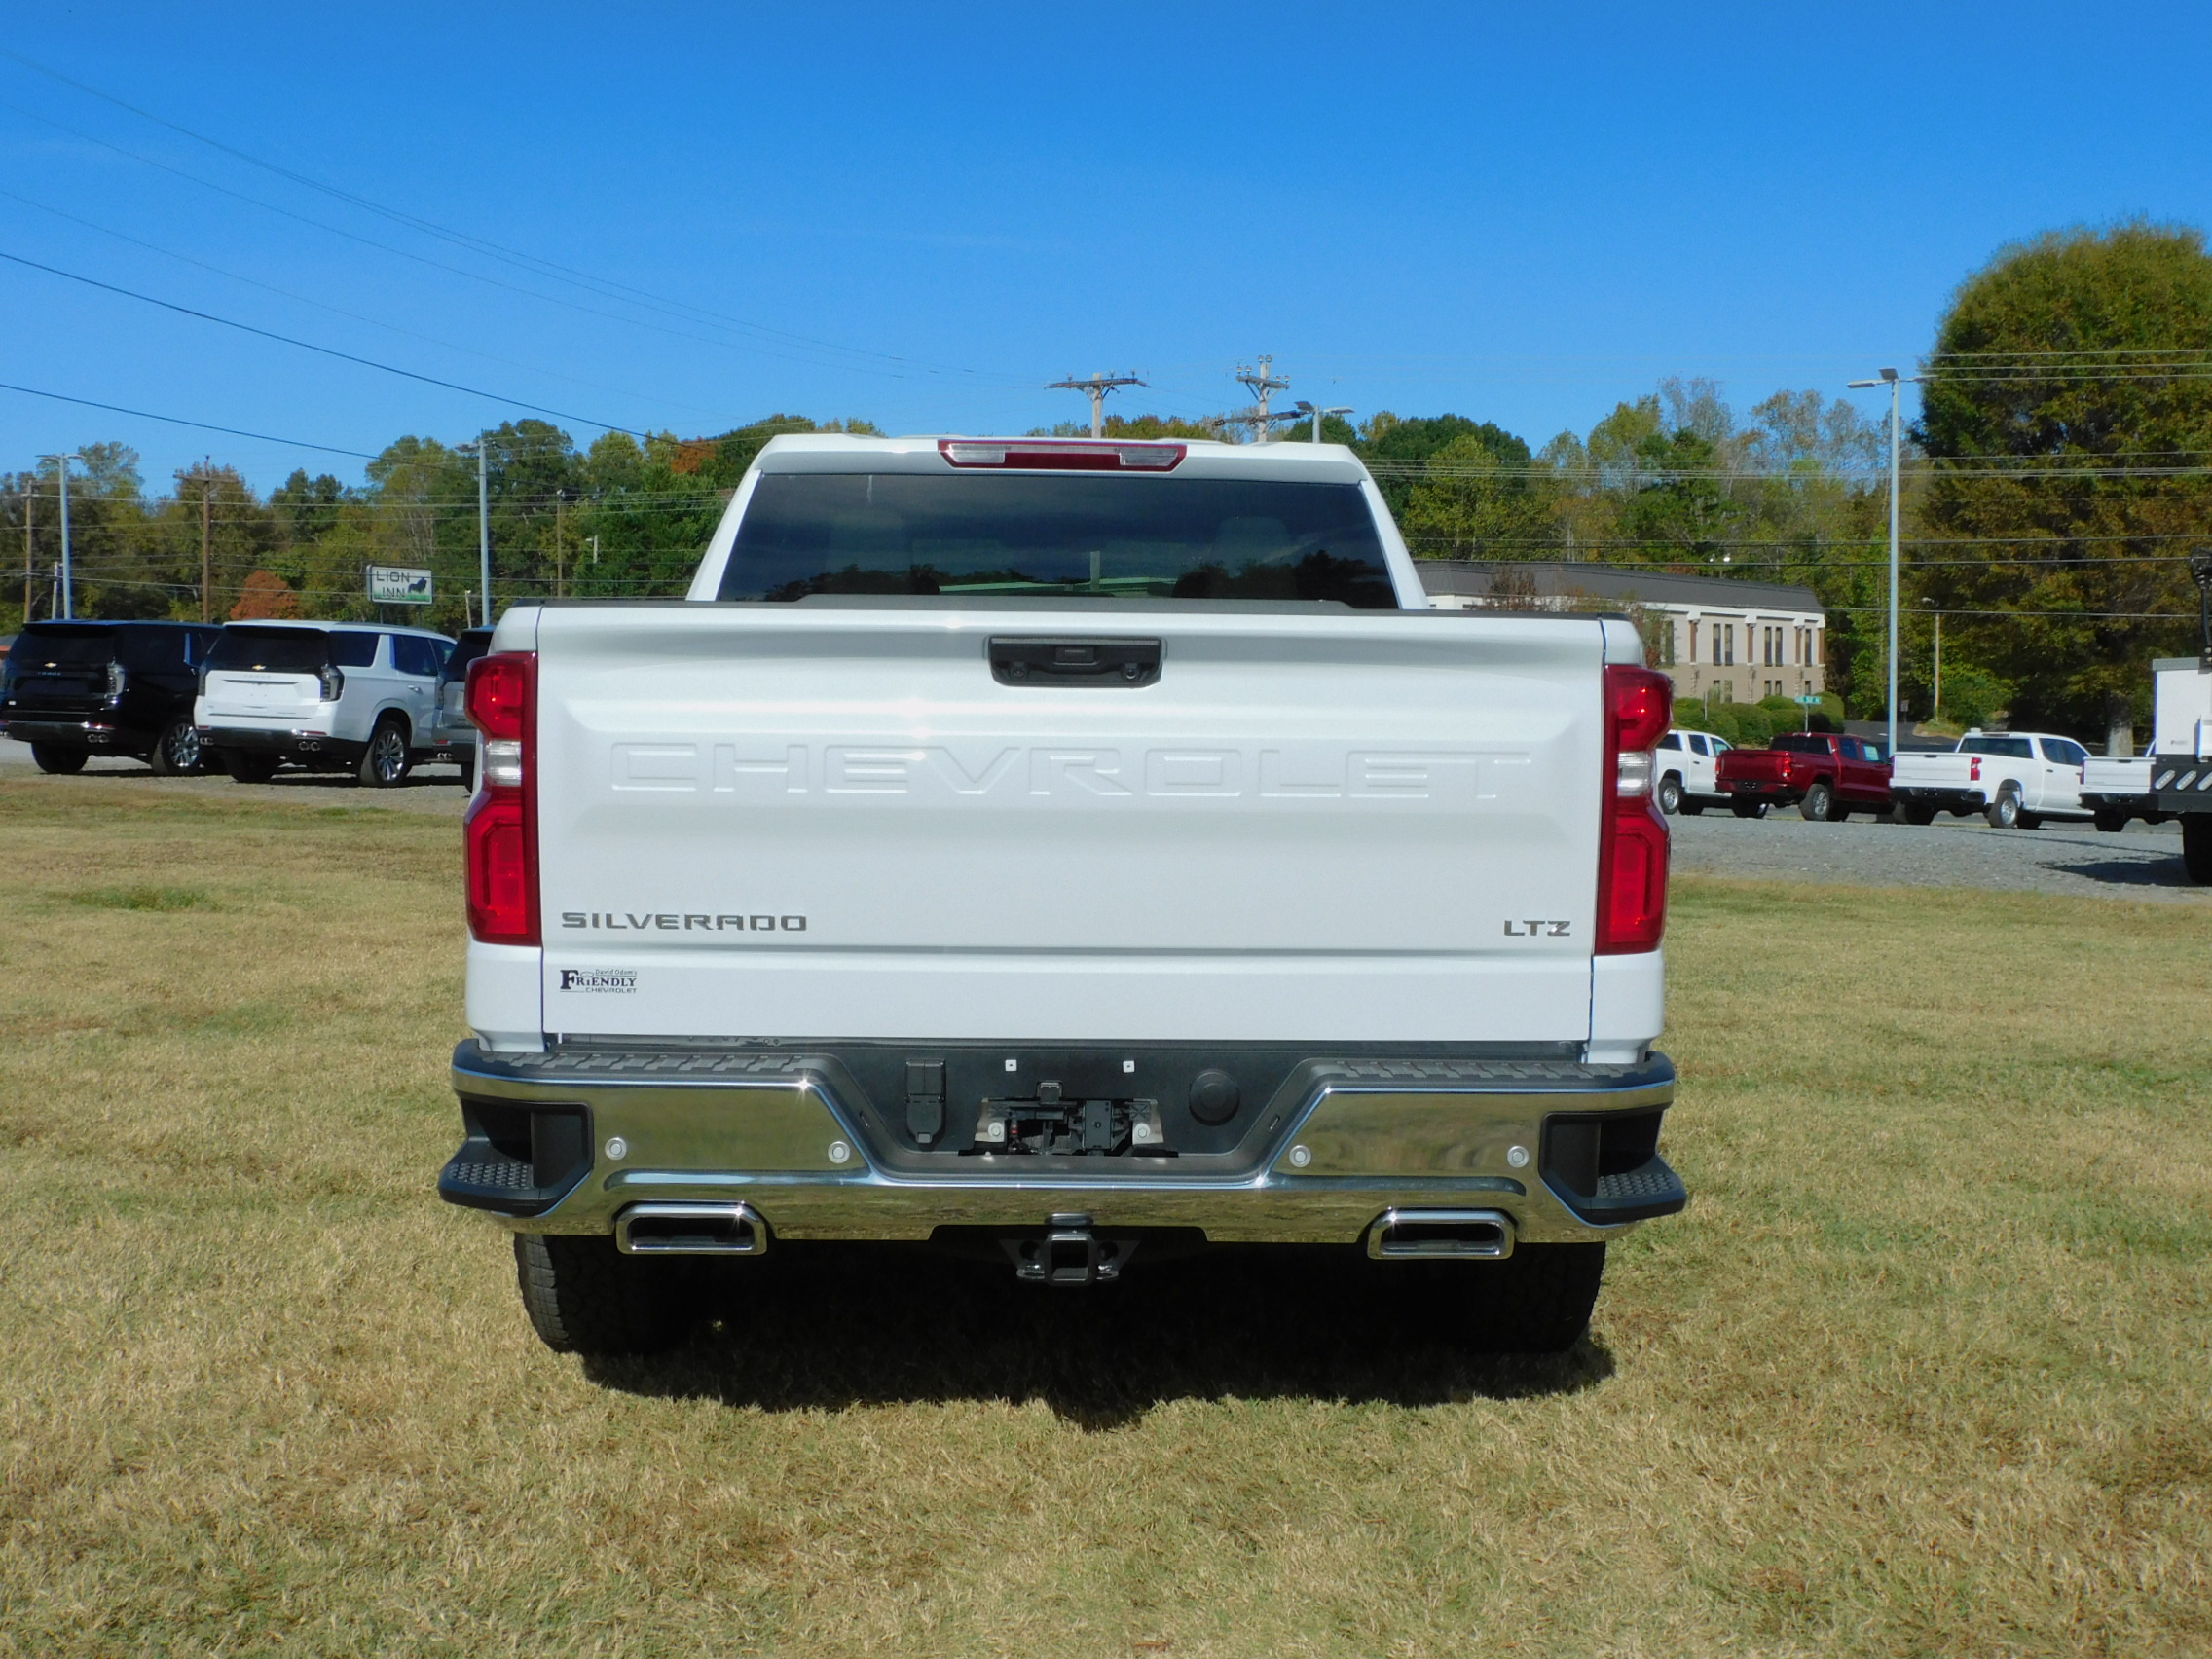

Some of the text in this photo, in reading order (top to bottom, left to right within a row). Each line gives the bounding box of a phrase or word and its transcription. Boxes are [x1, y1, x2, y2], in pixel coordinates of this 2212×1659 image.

[377, 571, 410, 583] LION
[383, 586, 405, 598] INN
[610, 742, 1532, 799] CHEVROLET
[561, 912, 807, 932] SILVERADO
[1503, 919, 1571, 937] LTZ
